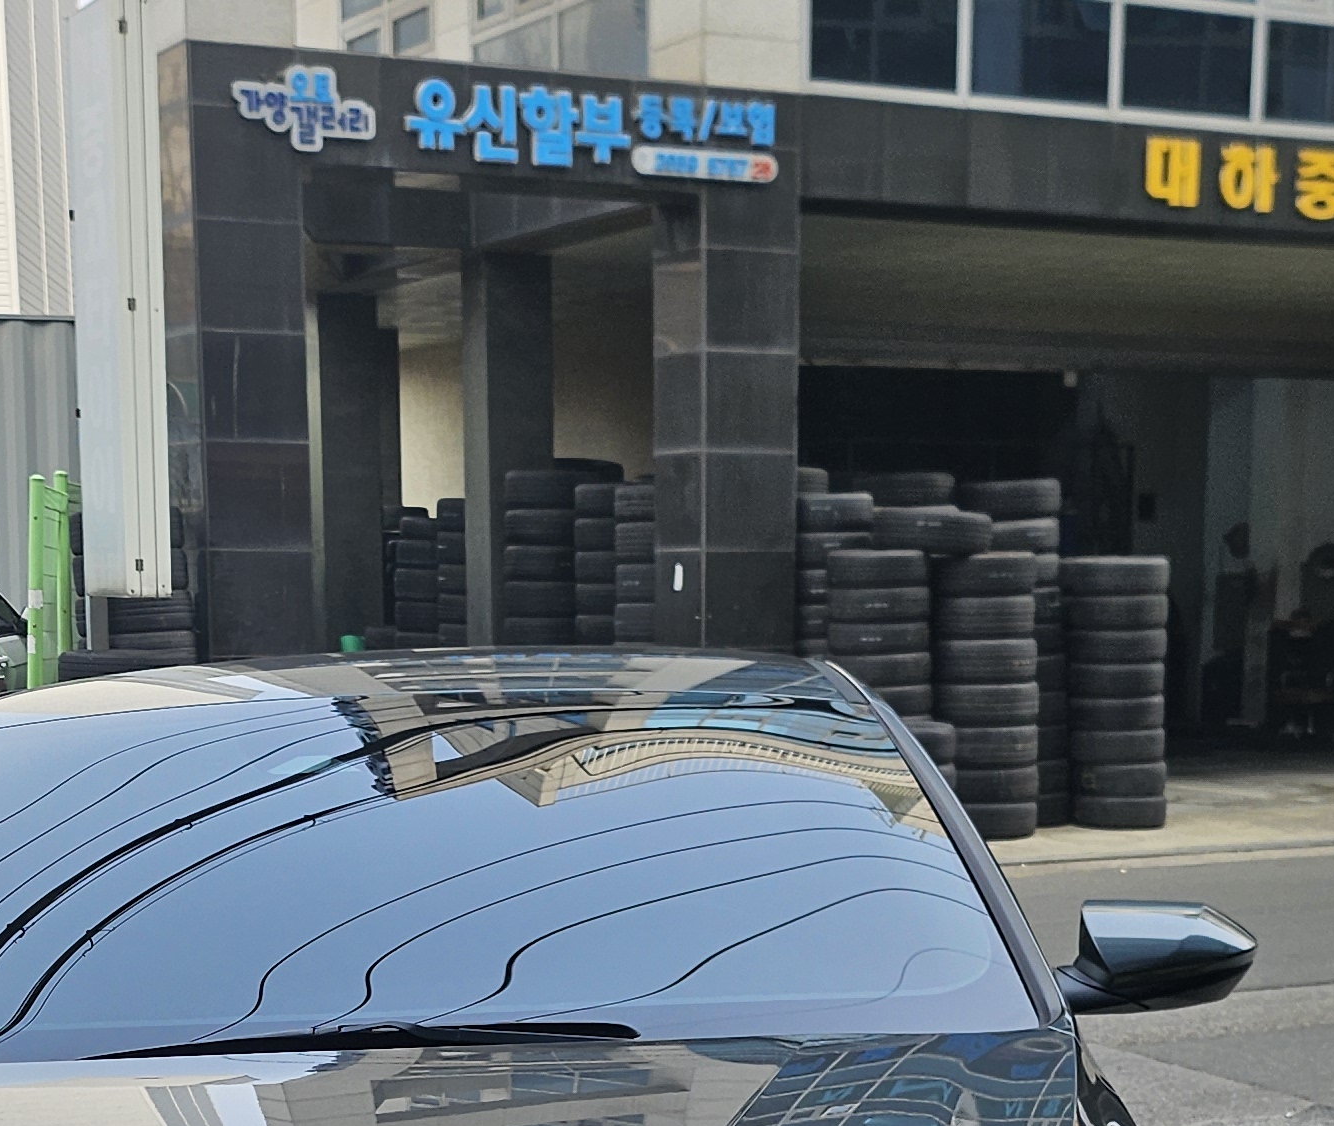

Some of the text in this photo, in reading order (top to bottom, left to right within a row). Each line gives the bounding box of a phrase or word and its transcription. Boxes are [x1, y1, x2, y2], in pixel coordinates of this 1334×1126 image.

[240, 89, 288, 126] 가양
[290, 105, 369, 145] 갤러리
[404, 78, 632, 168] 유신할부
